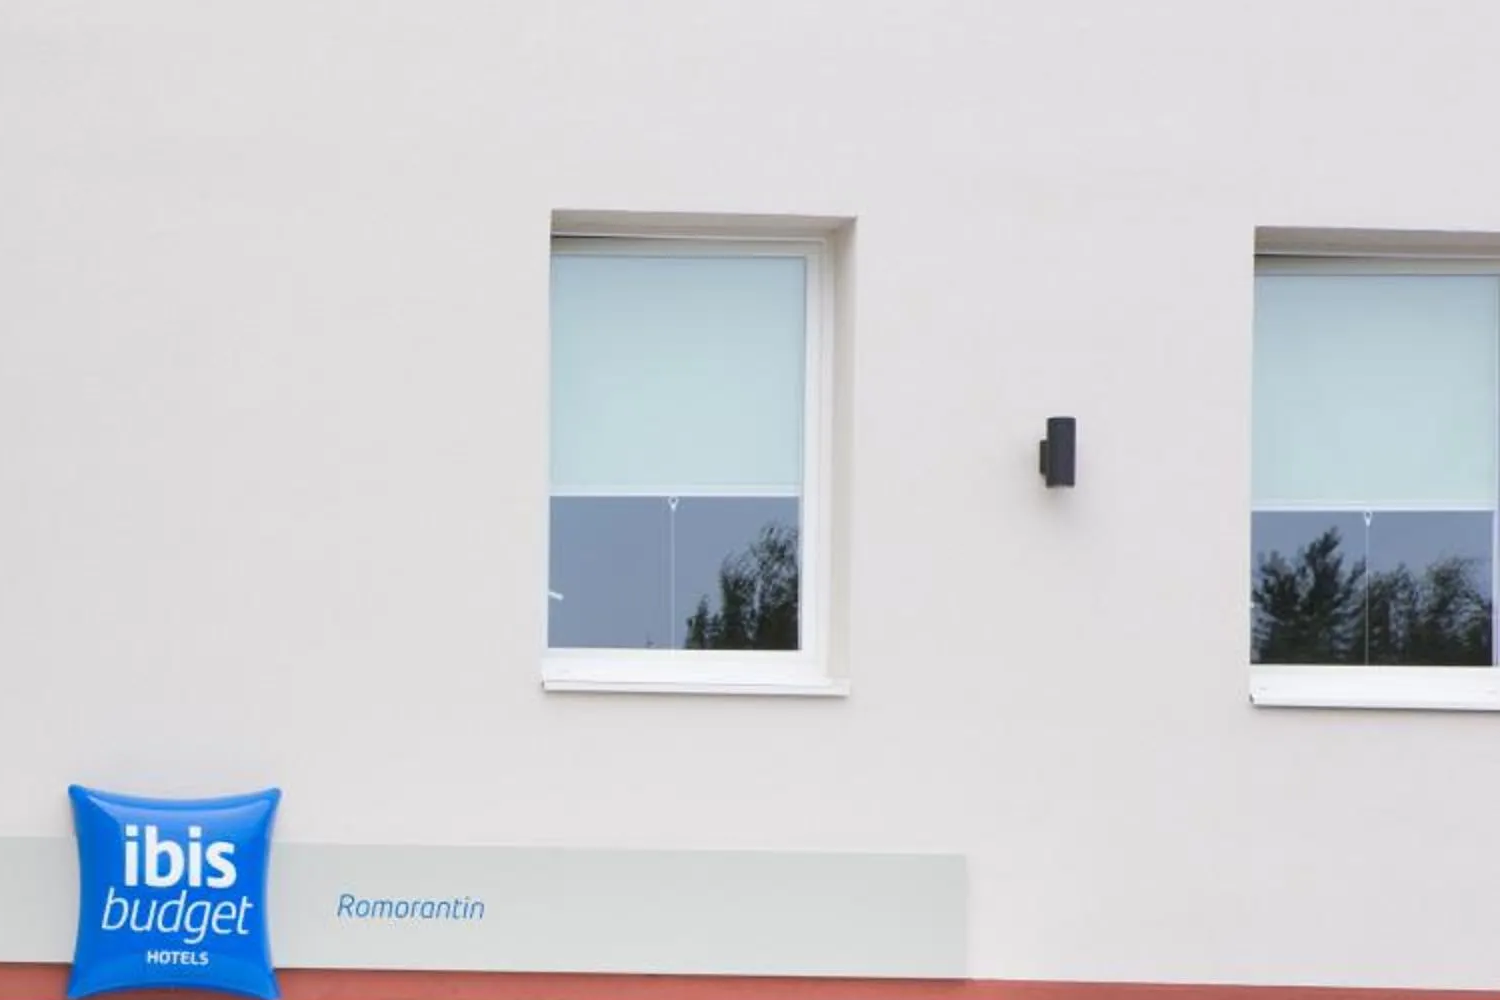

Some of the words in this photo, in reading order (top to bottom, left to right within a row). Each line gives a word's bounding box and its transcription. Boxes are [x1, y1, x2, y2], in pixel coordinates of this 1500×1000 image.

[124, 824, 237, 889] ibis
[101, 887, 254, 944] budget
[336, 893, 486, 921] Romorantin
[146, 950, 209, 966] HOTELS
